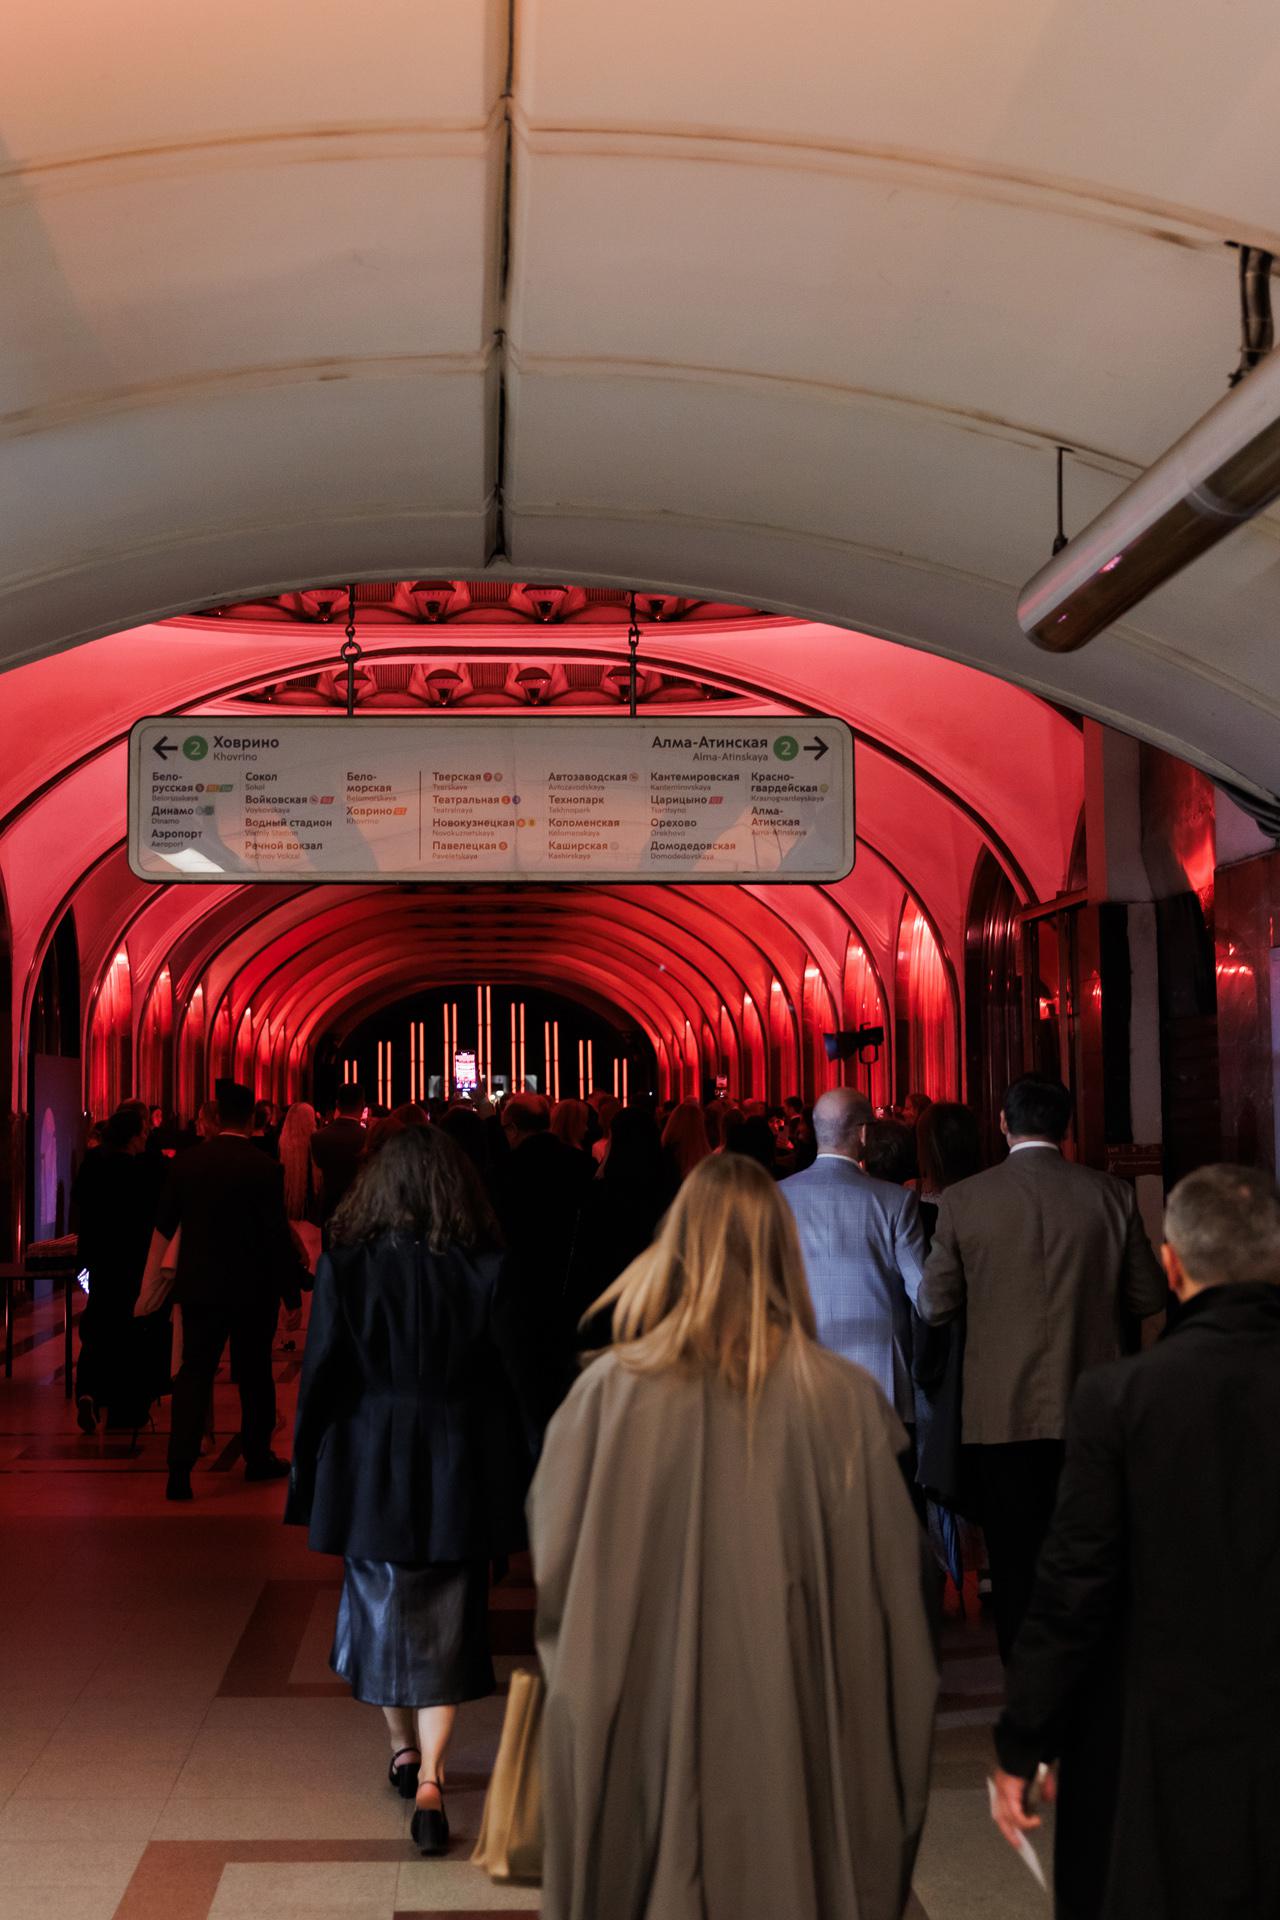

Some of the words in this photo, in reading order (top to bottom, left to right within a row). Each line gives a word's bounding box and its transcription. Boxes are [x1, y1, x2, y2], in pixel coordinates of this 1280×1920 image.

[190, 741, 201, 756] 2
[213, 735, 280, 751] Ховрино
[652, 735, 768, 749] Алма-Атинская
[780, 741, 792, 756] 2
[213, 752, 258, 761] Khovrino
[693, 752, 769, 763] Alma-Atinskaya
[152, 772, 183, 781] Бело-
[245, 772, 278, 781] Сокол
[346, 772, 377, 781] Бело-
[432, 772, 482, 783] Тверская
[548, 772, 628, 782] Автозаводская
[650, 772, 740, 783] Кантемировская
[751, 772, 794, 783] Красно-
[152, 783, 193, 793] русская
[346, 785, 392, 794] морская
[751, 783, 818, 793] гвардейская
[245, 795, 308, 804] Войковская
[432, 795, 500, 805] Театральная
[548, 795, 605, 806] Технопарк
[650, 795, 708, 806] Царицыно
[151, 806, 194, 816] Динамо
[346, 806, 393, 817] Ховрино
[751, 806, 784, 815] Алма-
[245, 818, 287, 828] Водный
[289, 820, 333, 828] стадион
[432, 818, 515, 829] Новокузнецкая
[548, 818, 620, 828] Коломенская
[650, 818, 697, 828] Орехово
[751, 818, 800, 826] Атинская
[151, 830, 203, 840] Аэропорт
[286, 842, 323, 850] вокзал
[432, 841, 497, 852] Павелецкая
[548, 841, 608, 852] Каширская
[650, 841, 736, 851] Домодедовская
